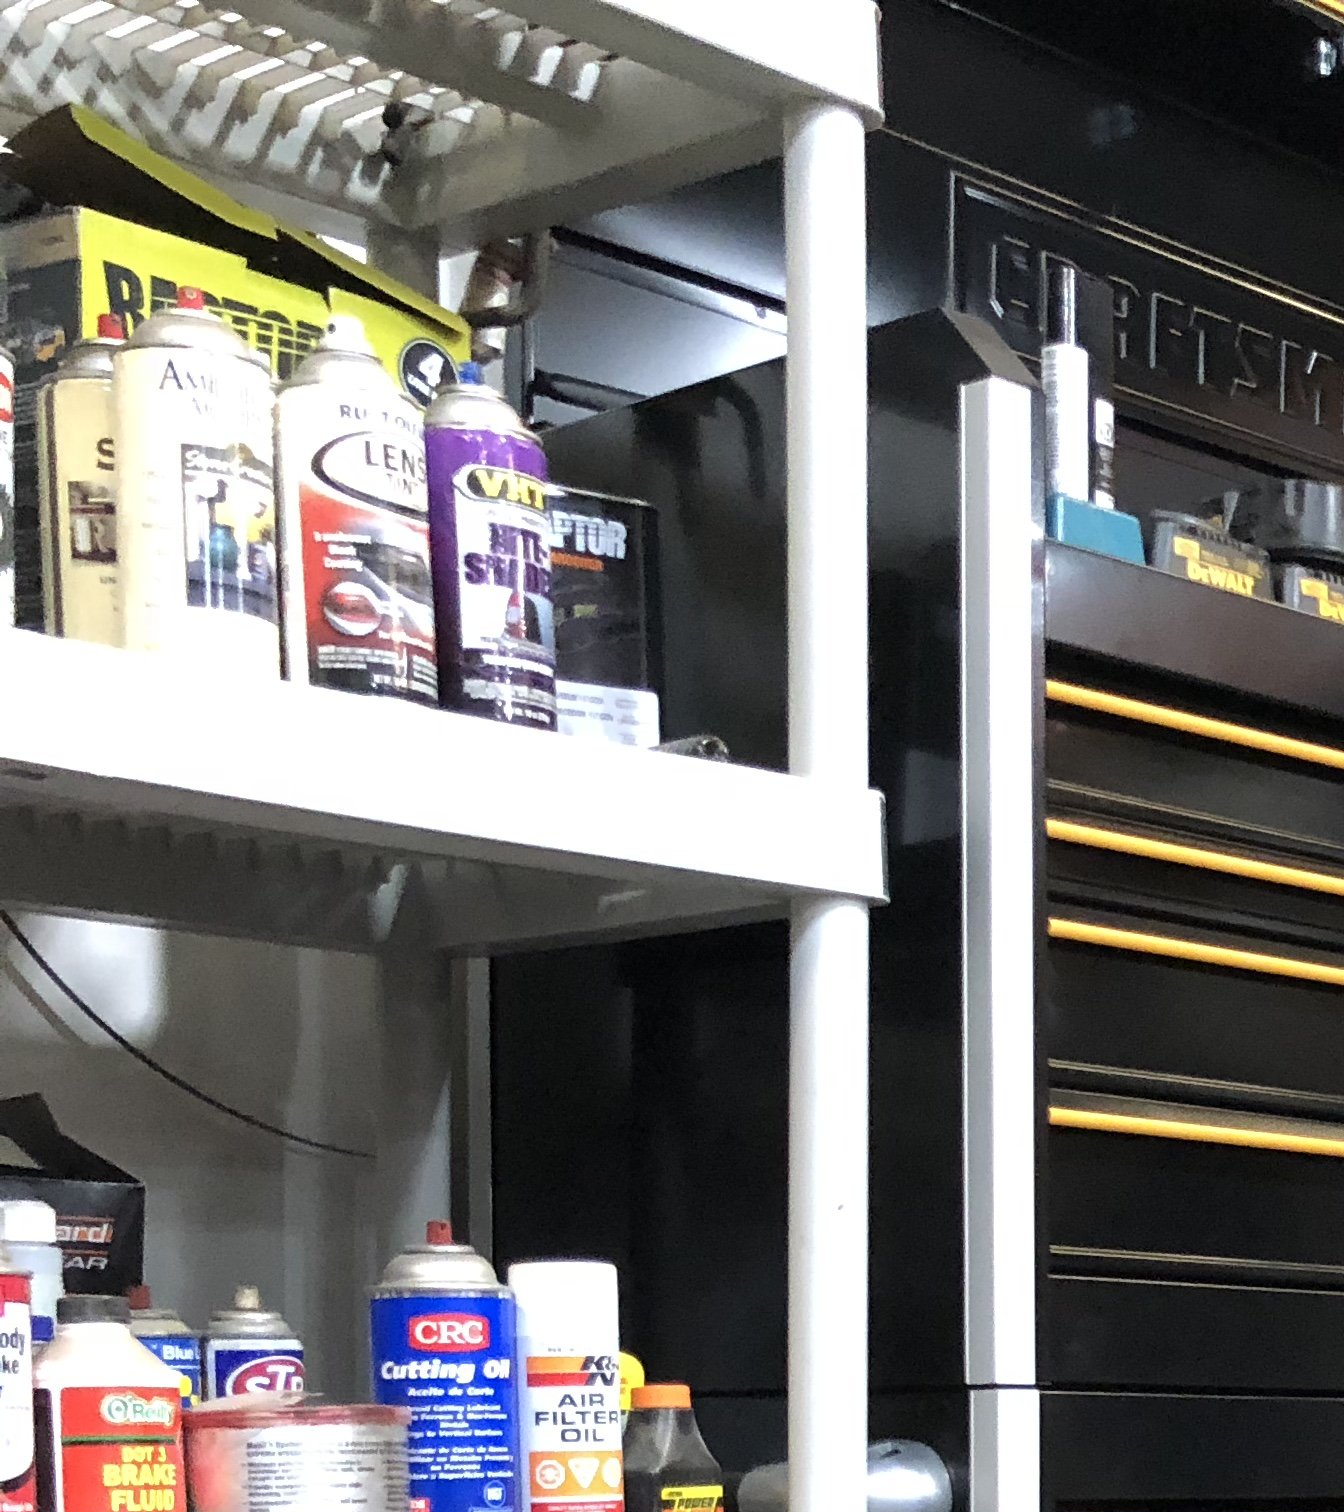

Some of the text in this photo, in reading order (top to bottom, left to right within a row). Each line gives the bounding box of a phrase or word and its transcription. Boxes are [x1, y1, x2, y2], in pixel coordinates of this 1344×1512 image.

[551, 511, 628, 560] PTOR
[414, 1320, 484, 1344] CRC
[162, 1345, 193, 1361] Blue
[381, 1358, 475, 1384] Cutting
[558, 1393, 605, 1408] AIR
[534, 1411, 619, 1427] FILTER
[560, 1428, 605, 1444] OIL
[121, 1445, 154, 1463] DOT
[102, 1463, 177, 1487] BRAKE
[110, 1488, 176, 1512] FLUID
